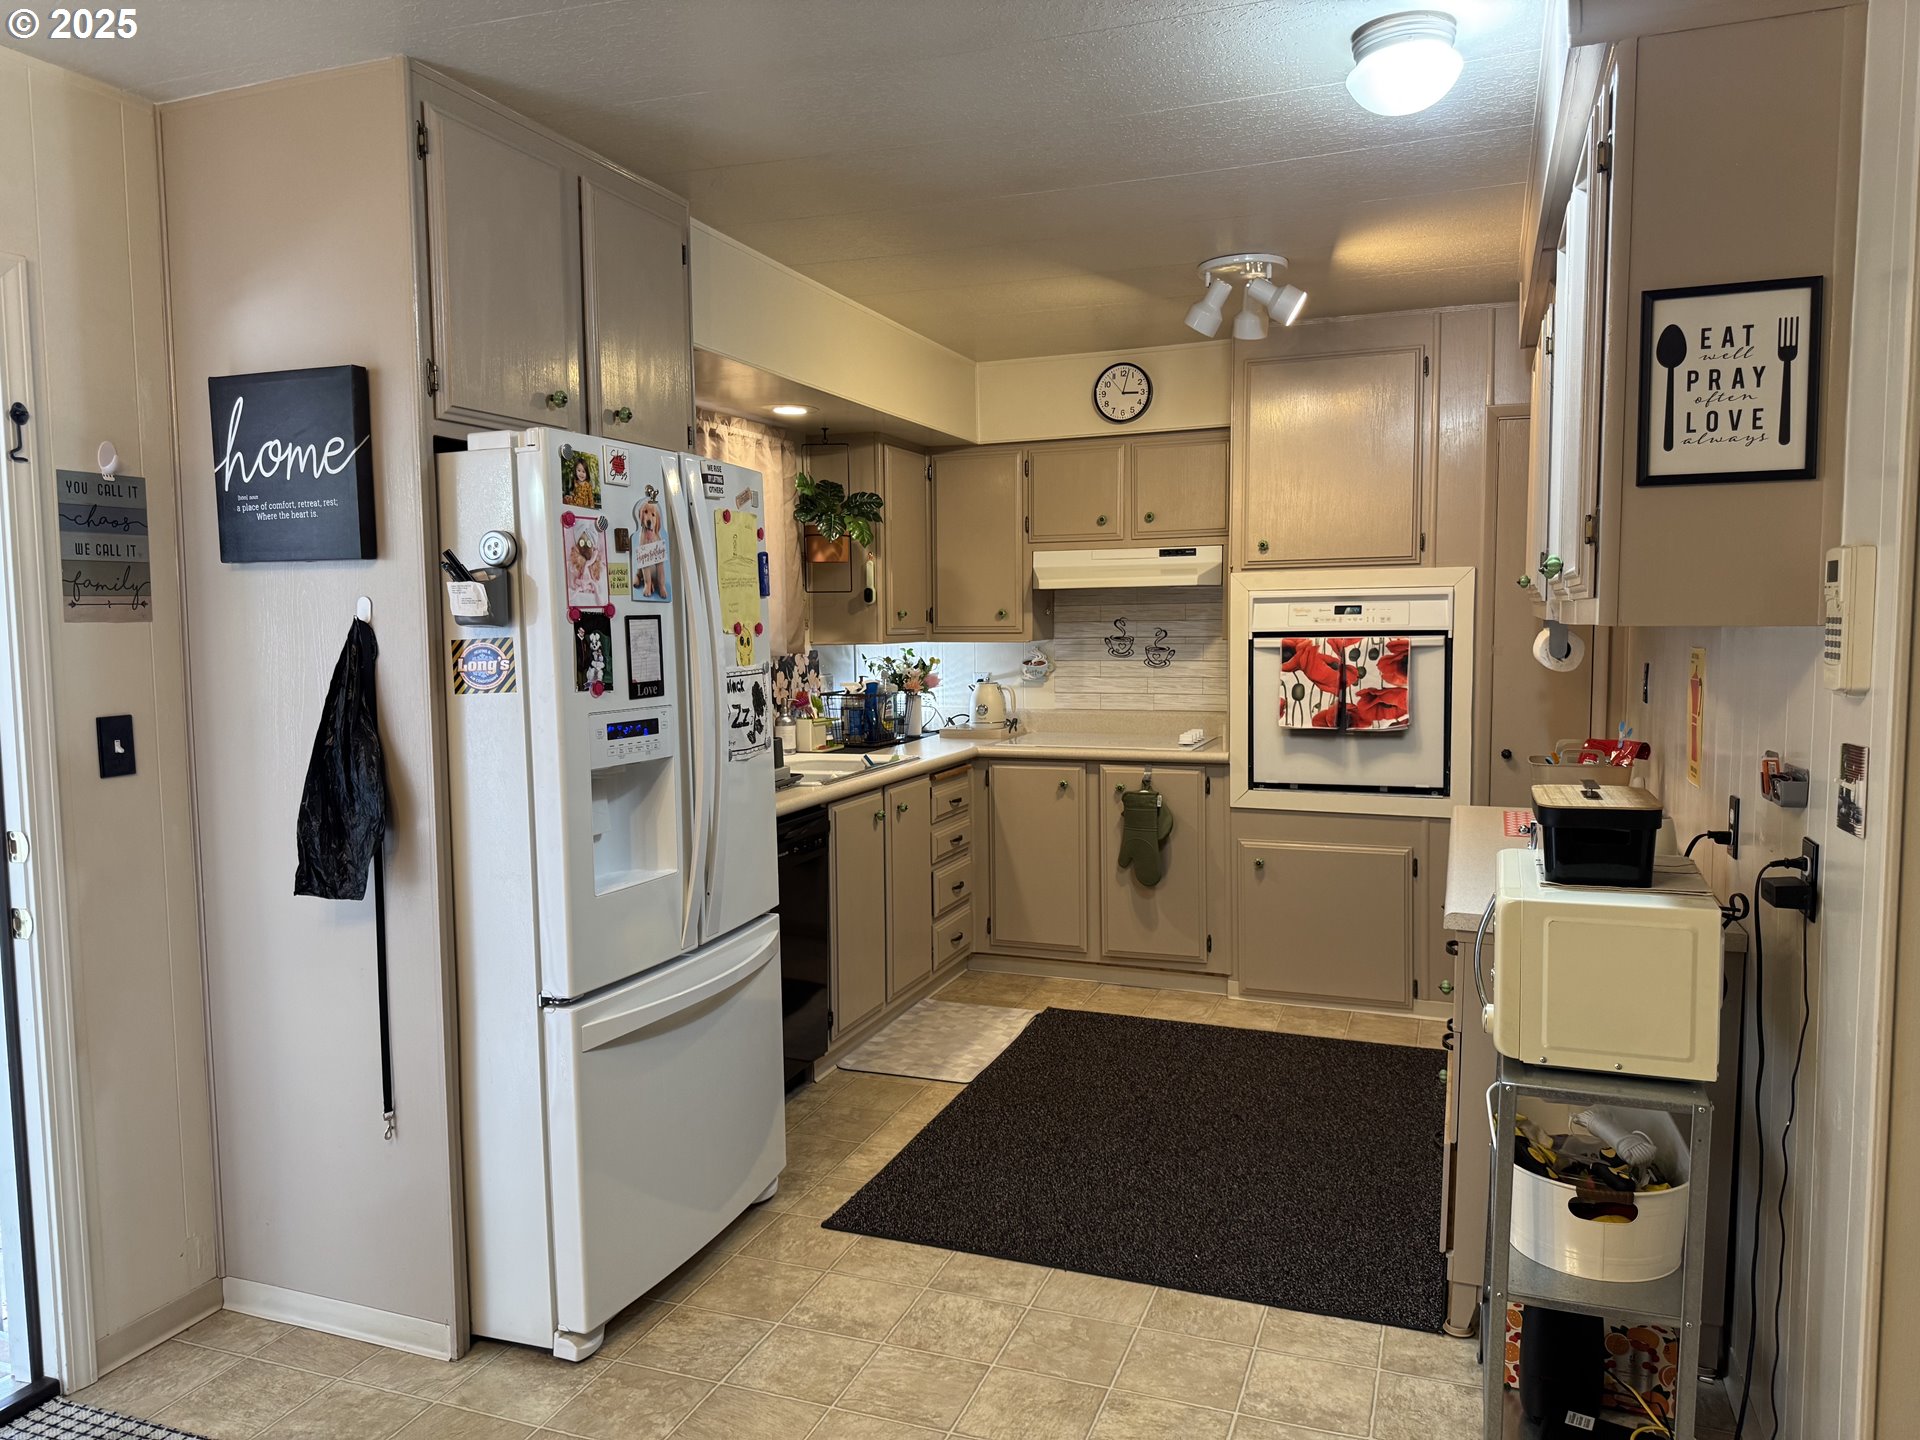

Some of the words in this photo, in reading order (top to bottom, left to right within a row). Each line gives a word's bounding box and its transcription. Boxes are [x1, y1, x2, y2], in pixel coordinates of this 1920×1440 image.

[1701, 324, 1754, 349] EAT
[1699, 346, 1754, 361] well
[1687, 366, 1766, 392] PRAY
[1695, 391, 1757, 407] often
[1686, 408, 1764, 433] LOVE
[214, 396, 370, 492] home
[1681, 432, 1768, 447] always
[707, 464, 713, 472] WE
[713, 465, 722, 473] RISE
[66, 480, 88, 494] YOU
[98, 484, 123, 497] CALL
[128, 486, 138, 499] IT
[709, 486, 724, 495] OTHERS
[242, 503, 259, 513] place
[260, 502, 268, 511] of
[268, 500, 296, 510] comfort,
[298, 499, 322, 508] retreat,
[60, 504, 147, 532] chaos
[256, 512, 278, 520] Where
[279, 511, 290, 519] the
[291, 510, 309, 519] heart
[310, 510, 319, 518] is.
[75, 543, 90, 556] WE
[96, 544, 121, 557] CALL
[126, 545, 136, 557] IT
[64, 565, 150, 610] family
[458, 657, 509, 674] Long's
[637, 684, 658, 696] Love
